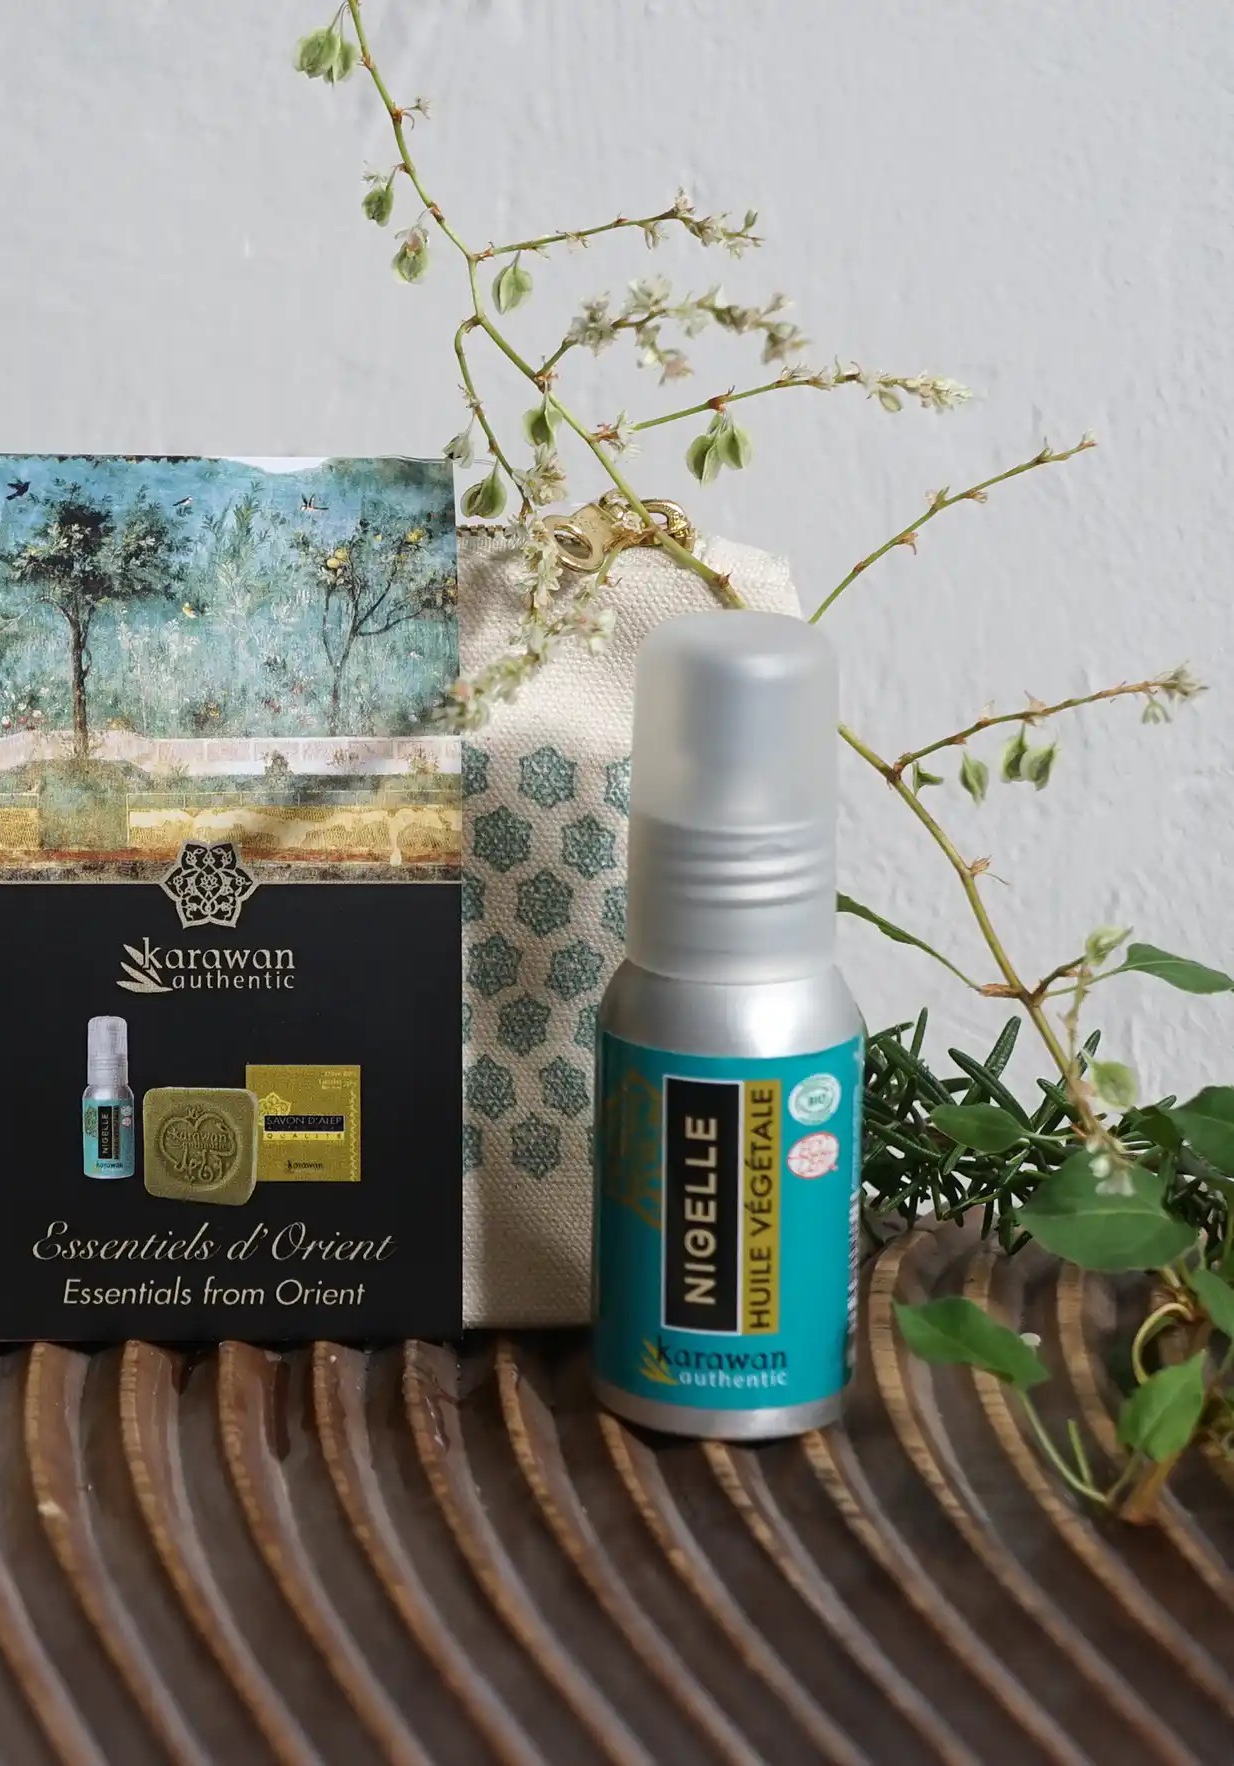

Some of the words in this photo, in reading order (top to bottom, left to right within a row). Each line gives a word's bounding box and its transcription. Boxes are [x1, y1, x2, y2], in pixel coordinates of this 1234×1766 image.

[142, 937, 296, 969] karawan
[172, 970, 295, 989] authentic
[266, 1116, 306, 1125] SAVON
[744, 1088, 775, 1236] VÉGÉTALE
[684, 1116, 717, 1305] NIGELLE
[32, 1220, 222, 1261] Essentiels
[63, 1276, 193, 1305] Essentials
[203, 1276, 265, 1305] from
[275, 1278, 366, 1306] Orient
[750, 1247, 772, 1329] HUILE
[656, 1335, 788, 1371] karawan
[679, 1369, 788, 1388] authentic
